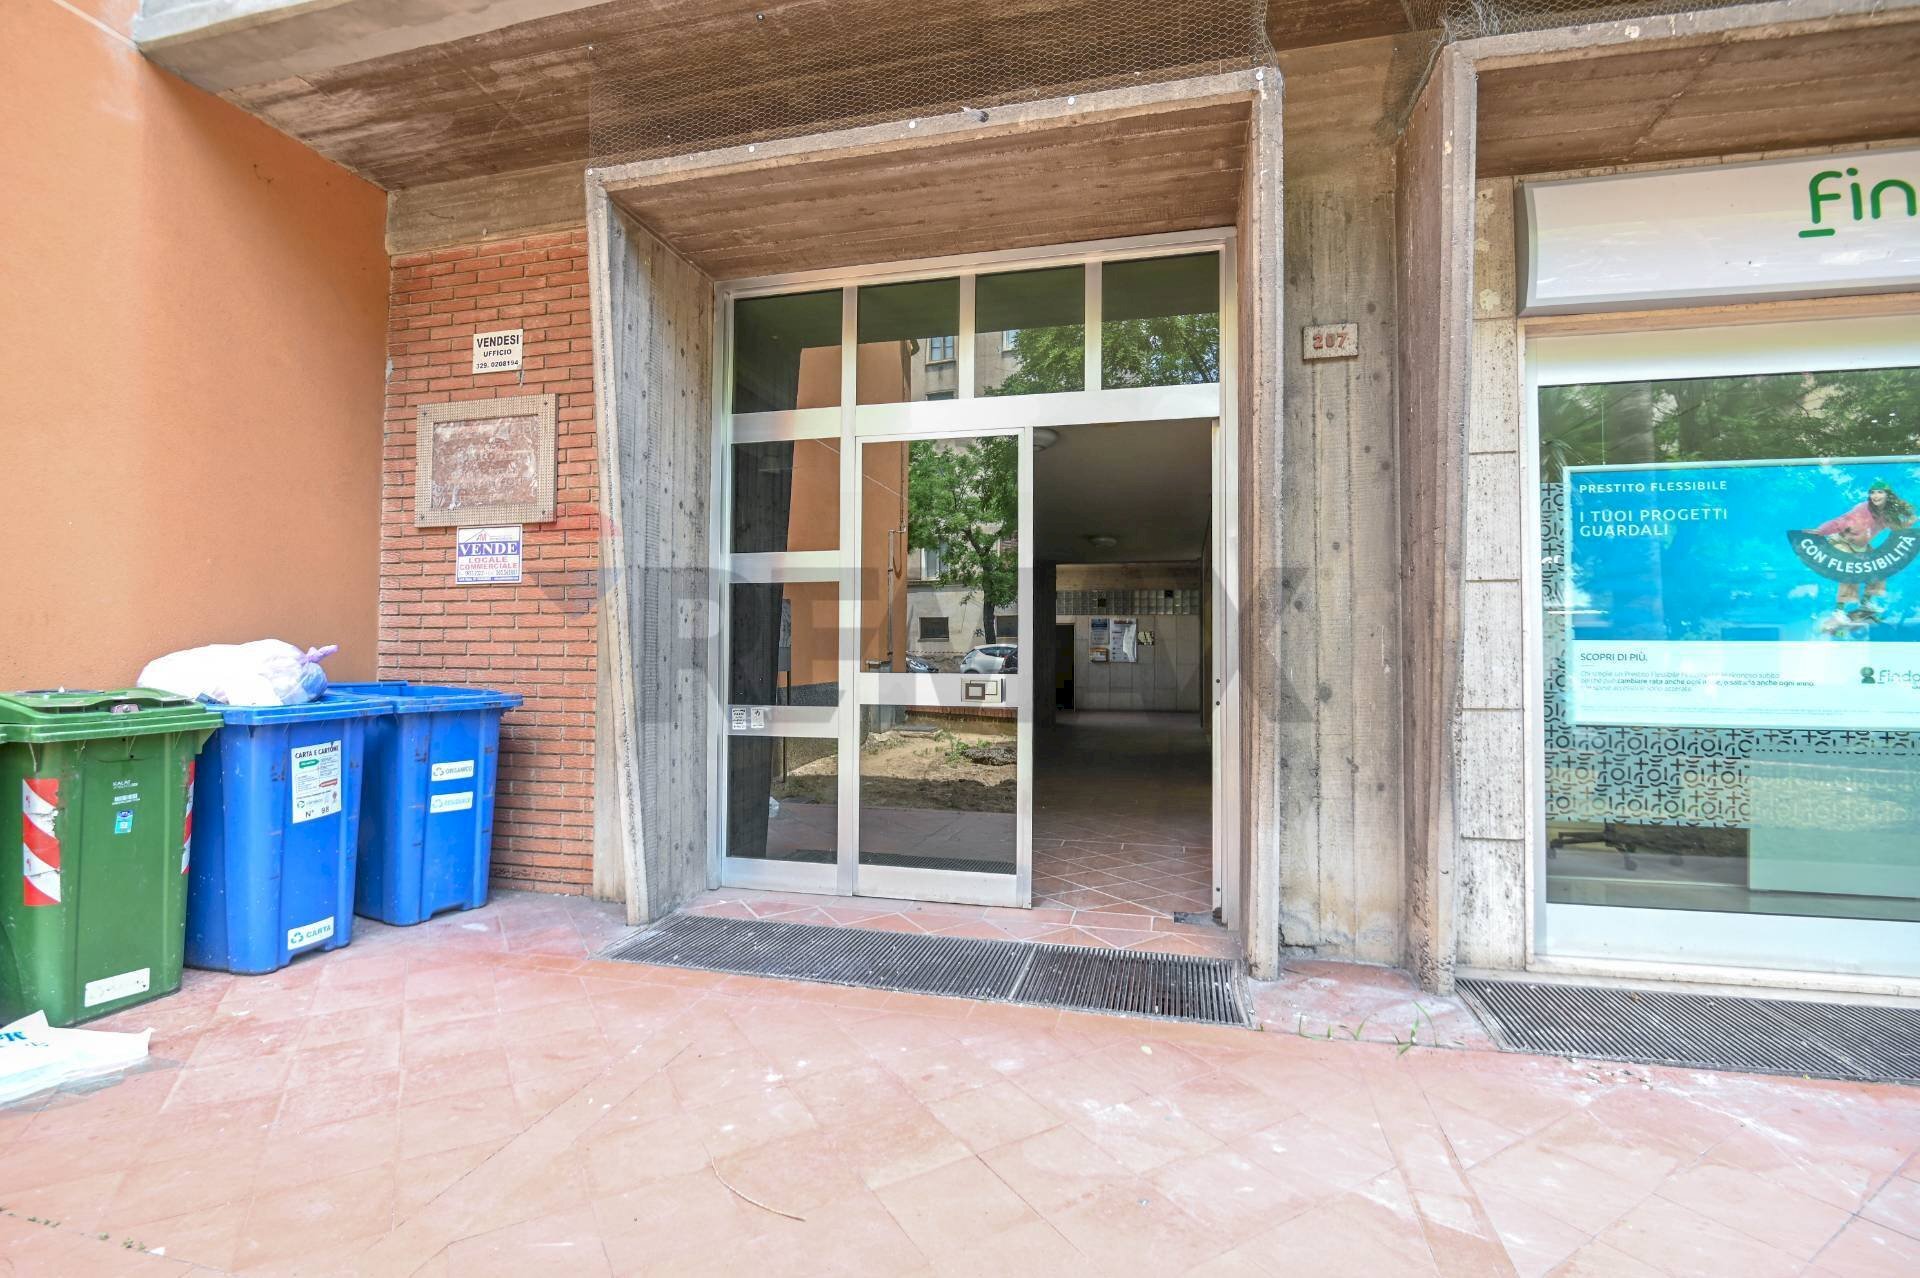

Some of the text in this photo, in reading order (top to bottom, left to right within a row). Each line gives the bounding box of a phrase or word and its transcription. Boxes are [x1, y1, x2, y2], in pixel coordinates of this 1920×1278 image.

[477, 335, 519, 348] VENDESI
[1313, 331, 1347, 349] 207
[483, 349, 512, 357] UFFICIO
[1579, 481, 1728, 493] PRESTITO FLESSIBILE
[1591, 510, 1633, 522] TUOI
[1640, 508, 1728, 521] PROGETTI
[1580, 524, 1669, 537] GUARDALI
[459, 543, 518, 556] VENDE
[1800, 536, 1916, 574] CON FLESSIBILITÀ
[1580, 653, 1615, 661] SCOPRI
[1617, 653, 1627, 661] DI
[295, 750, 312, 759] CARTA
[306, 925, 331, 938] CARTA
